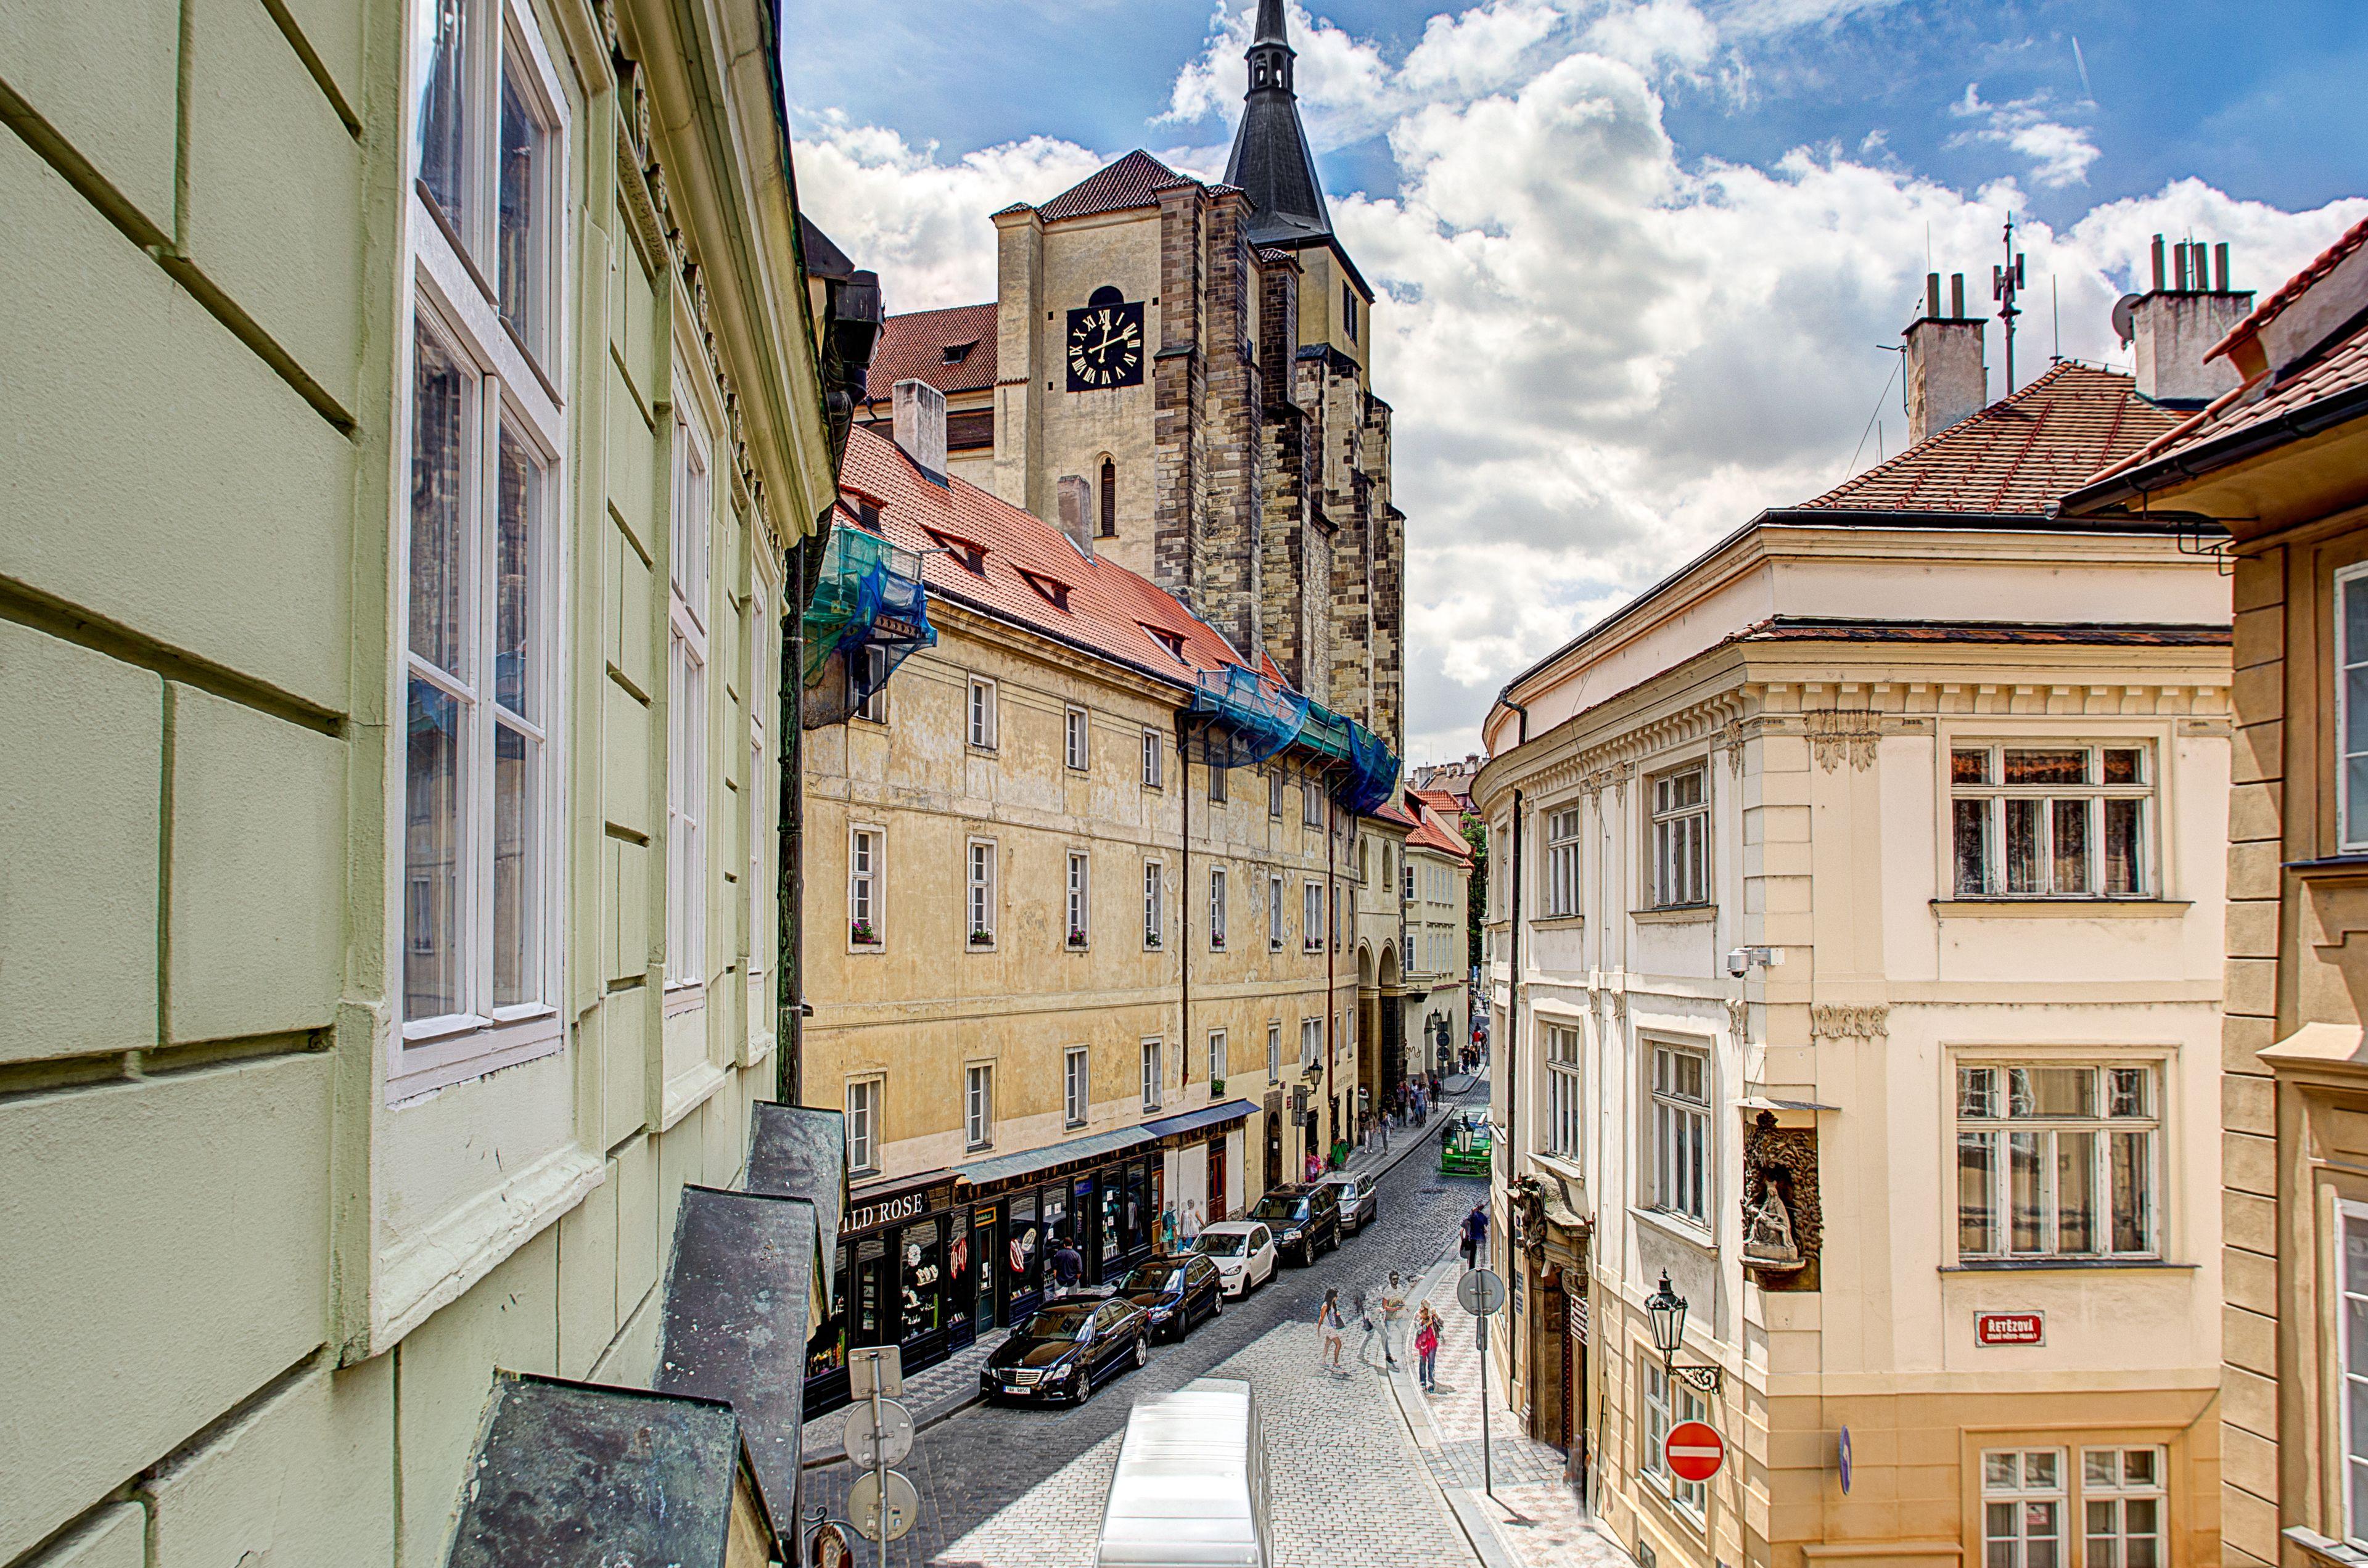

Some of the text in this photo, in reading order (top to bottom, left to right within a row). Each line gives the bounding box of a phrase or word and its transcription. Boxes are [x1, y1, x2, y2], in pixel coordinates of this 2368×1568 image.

[843, 1193, 923, 1233] ILD ROSE
[1988, 1319, 2034, 1332] ŘETĚZOVÁ
